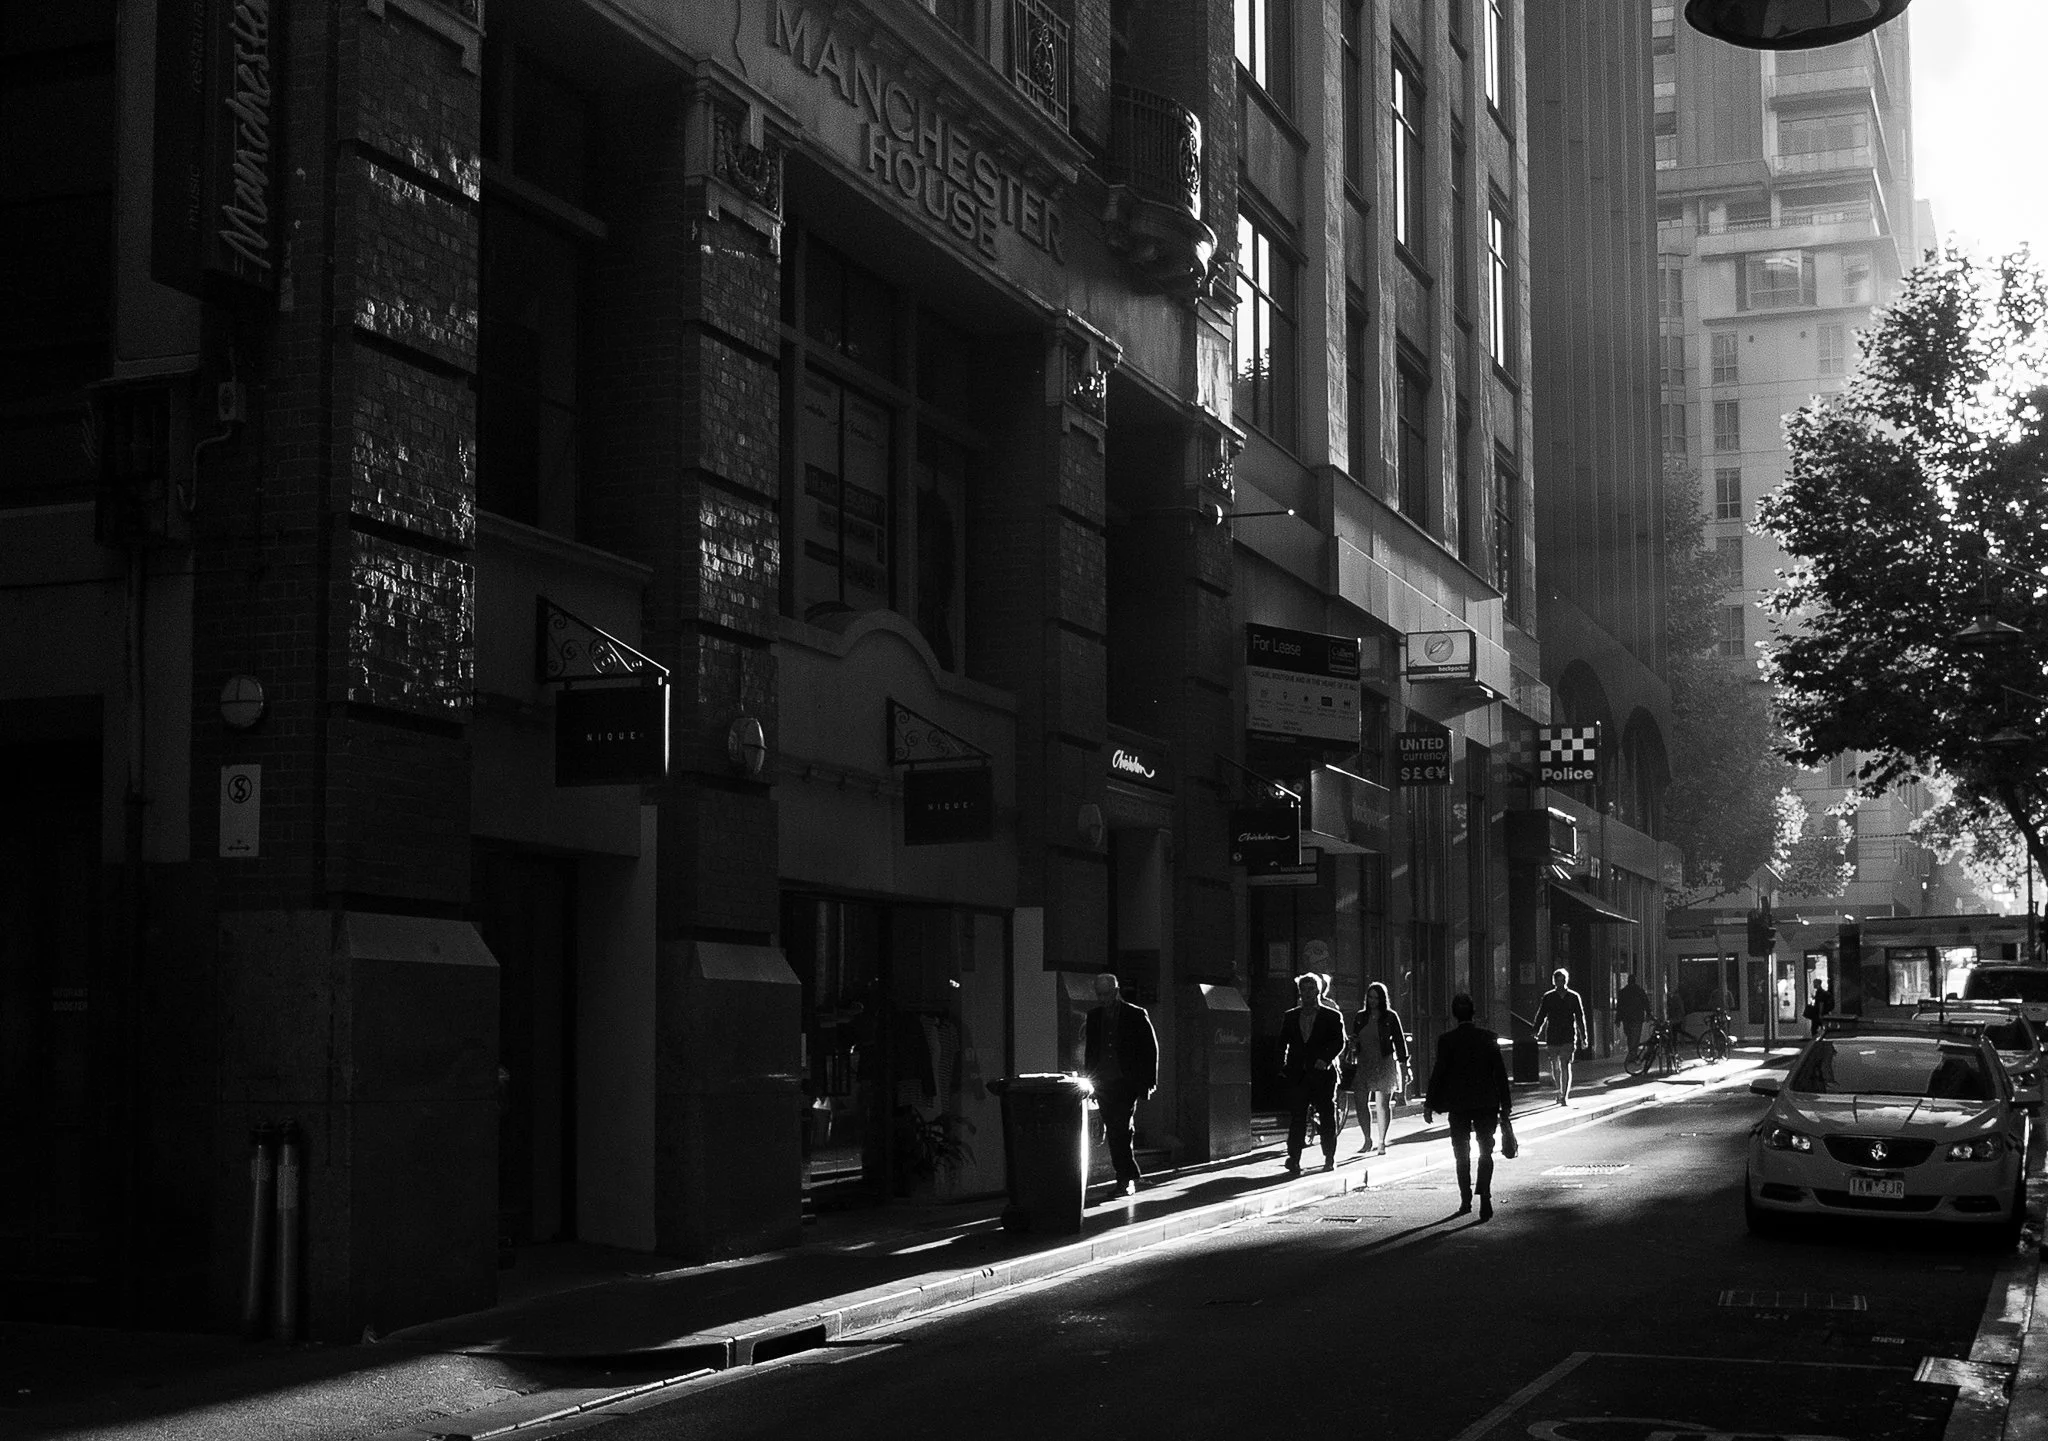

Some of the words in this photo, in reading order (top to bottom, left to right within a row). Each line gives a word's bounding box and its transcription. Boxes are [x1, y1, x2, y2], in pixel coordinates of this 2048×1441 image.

[773, 0, 1063, 265] MANCHESTER
[863, 122, 998, 261] HOUSE
[1252, 634, 1270, 652] For
[1273, 637, 1301, 657] Lease
[586, 731, 636, 742] NIQUE
[1402, 751, 1447, 763] currency
[1541, 766, 1594, 781] Police
